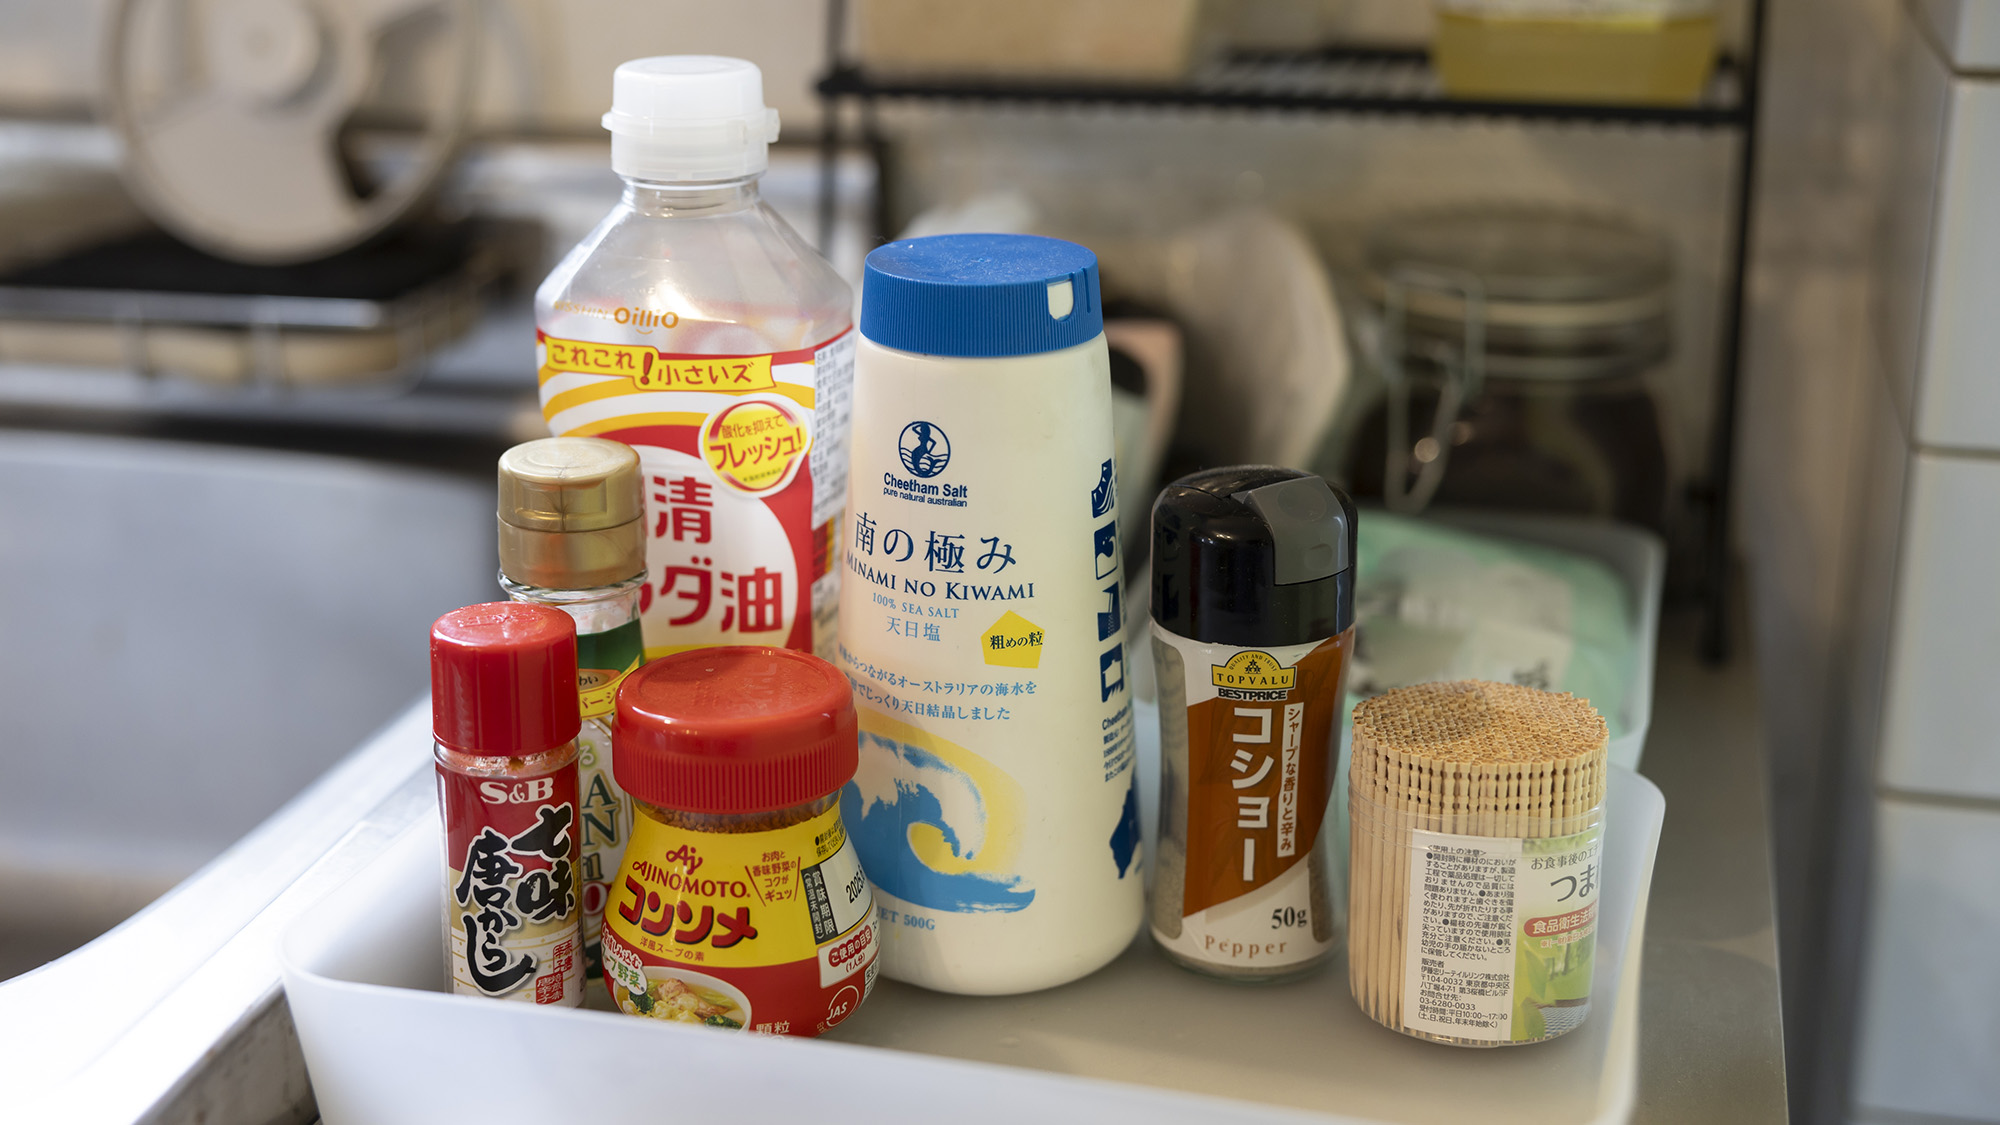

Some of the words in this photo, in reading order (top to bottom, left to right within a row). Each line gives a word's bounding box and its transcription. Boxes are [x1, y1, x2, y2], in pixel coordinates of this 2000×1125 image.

[709, 427, 802, 470] フレッシュ!
[883, 473, 939, 495] Cheetham
[942, 484, 967, 499] Salt
[883, 487, 898, 497] pure
[899, 491, 925, 503] natural
[927, 495, 967, 507] australian
[856, 512, 1016, 574] 南の極み
[846, 550, 896, 591] MINAMI
[904, 578, 936, 597] NO
[945, 582, 1035, 601] KIWAMI
[641, 557, 782, 634] ダ油
[872, 592, 897, 609] 100%
[901, 602, 923, 616] SEA
[928, 606, 959, 619] SALT
[886, 616, 941, 642] 天日塩
[990, 631, 1043, 650] 粗めの粒
[1229, 654, 1249, 670] QUALITY
[1263, 656, 1278, 672] TRUST
[1217, 673, 1289, 686] TOPVALU
[1218, 688, 1287, 701] BESTPRICE
[480, 778, 553, 804] S&B
[1281, 708, 1300, 851] シャープな香りと辛み
[1230, 707, 1274, 882] コショー
[511, 803, 575, 921] 七味
[752, 861, 796, 877] 香味野菜の
[762, 851, 786, 862] お肉と
[765, 876, 789, 888] コクが
[1551, 862, 1598, 902] つま
[765, 889, 792, 902] ギュッ
[812, 871, 835, 935] 賞味期限
[455, 829, 537, 993] 唐からし
[618, 875, 758, 949] コンソメ
[904, 914, 936, 931] 500G
[1271, 906, 1307, 929] 50g
[640, 936, 704, 962] 洋風スープの素
[1205, 935, 1287, 958] Pepper
[826, 1001, 848, 1020] JAS
[1420, 997, 1475, 1010] 03-6280-0033
